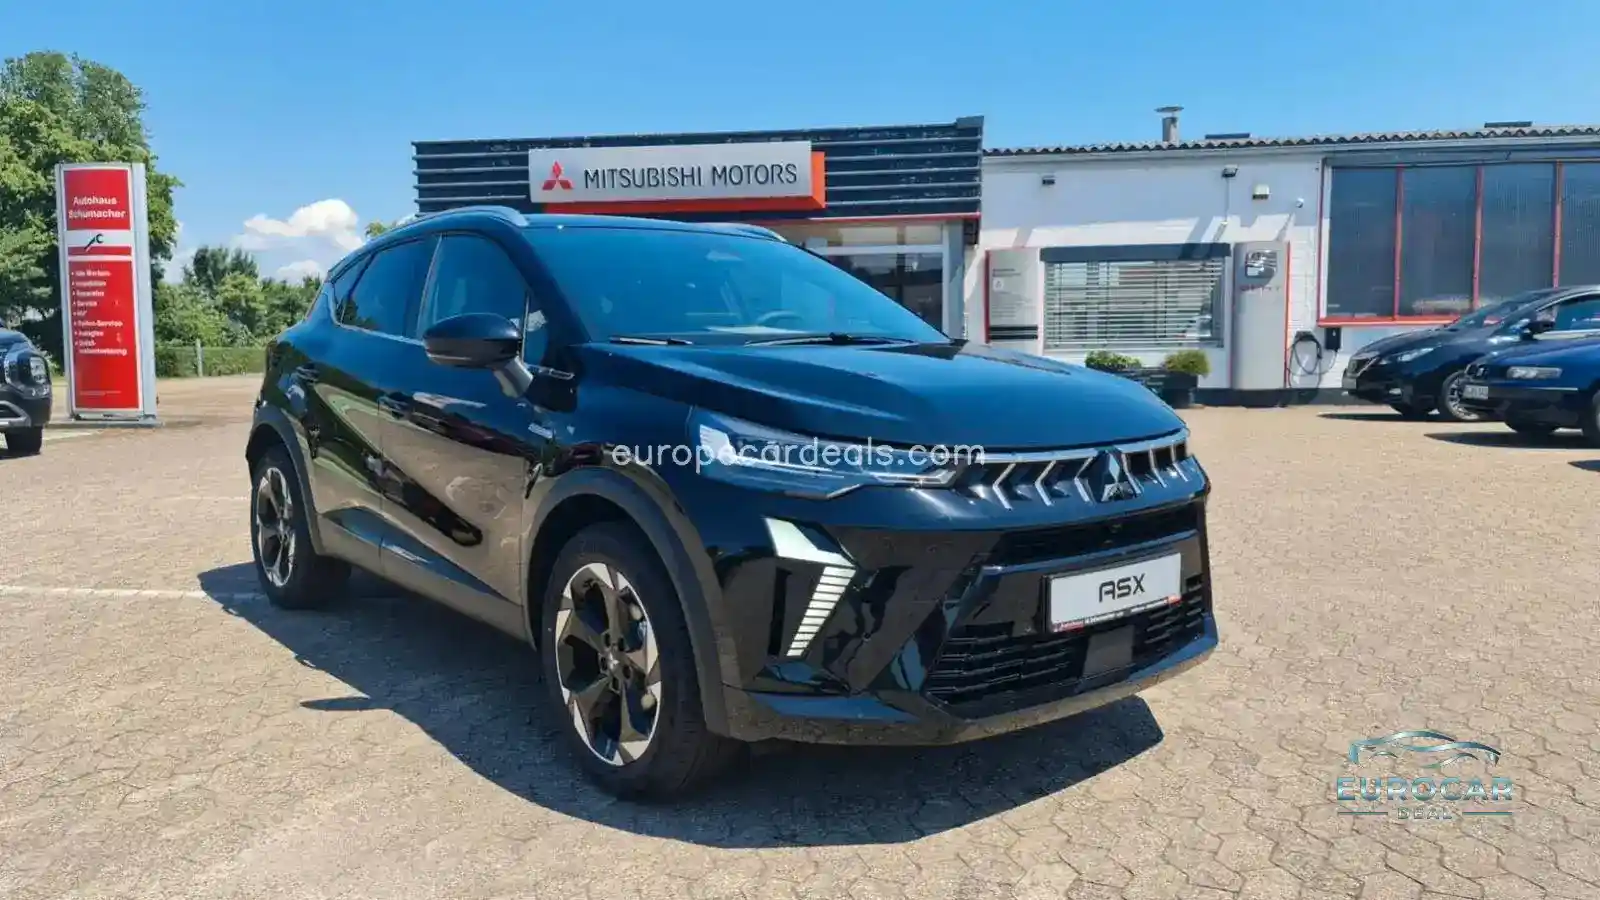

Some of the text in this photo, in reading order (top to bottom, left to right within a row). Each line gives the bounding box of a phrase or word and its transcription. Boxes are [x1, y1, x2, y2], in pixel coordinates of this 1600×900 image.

[584, 163, 798, 189] MITSUBISHI MOTORS
[72, 194, 118, 205] Autohaus
[68, 208, 126, 219] Schumacher
[1098, 573, 1146, 603] ASX
